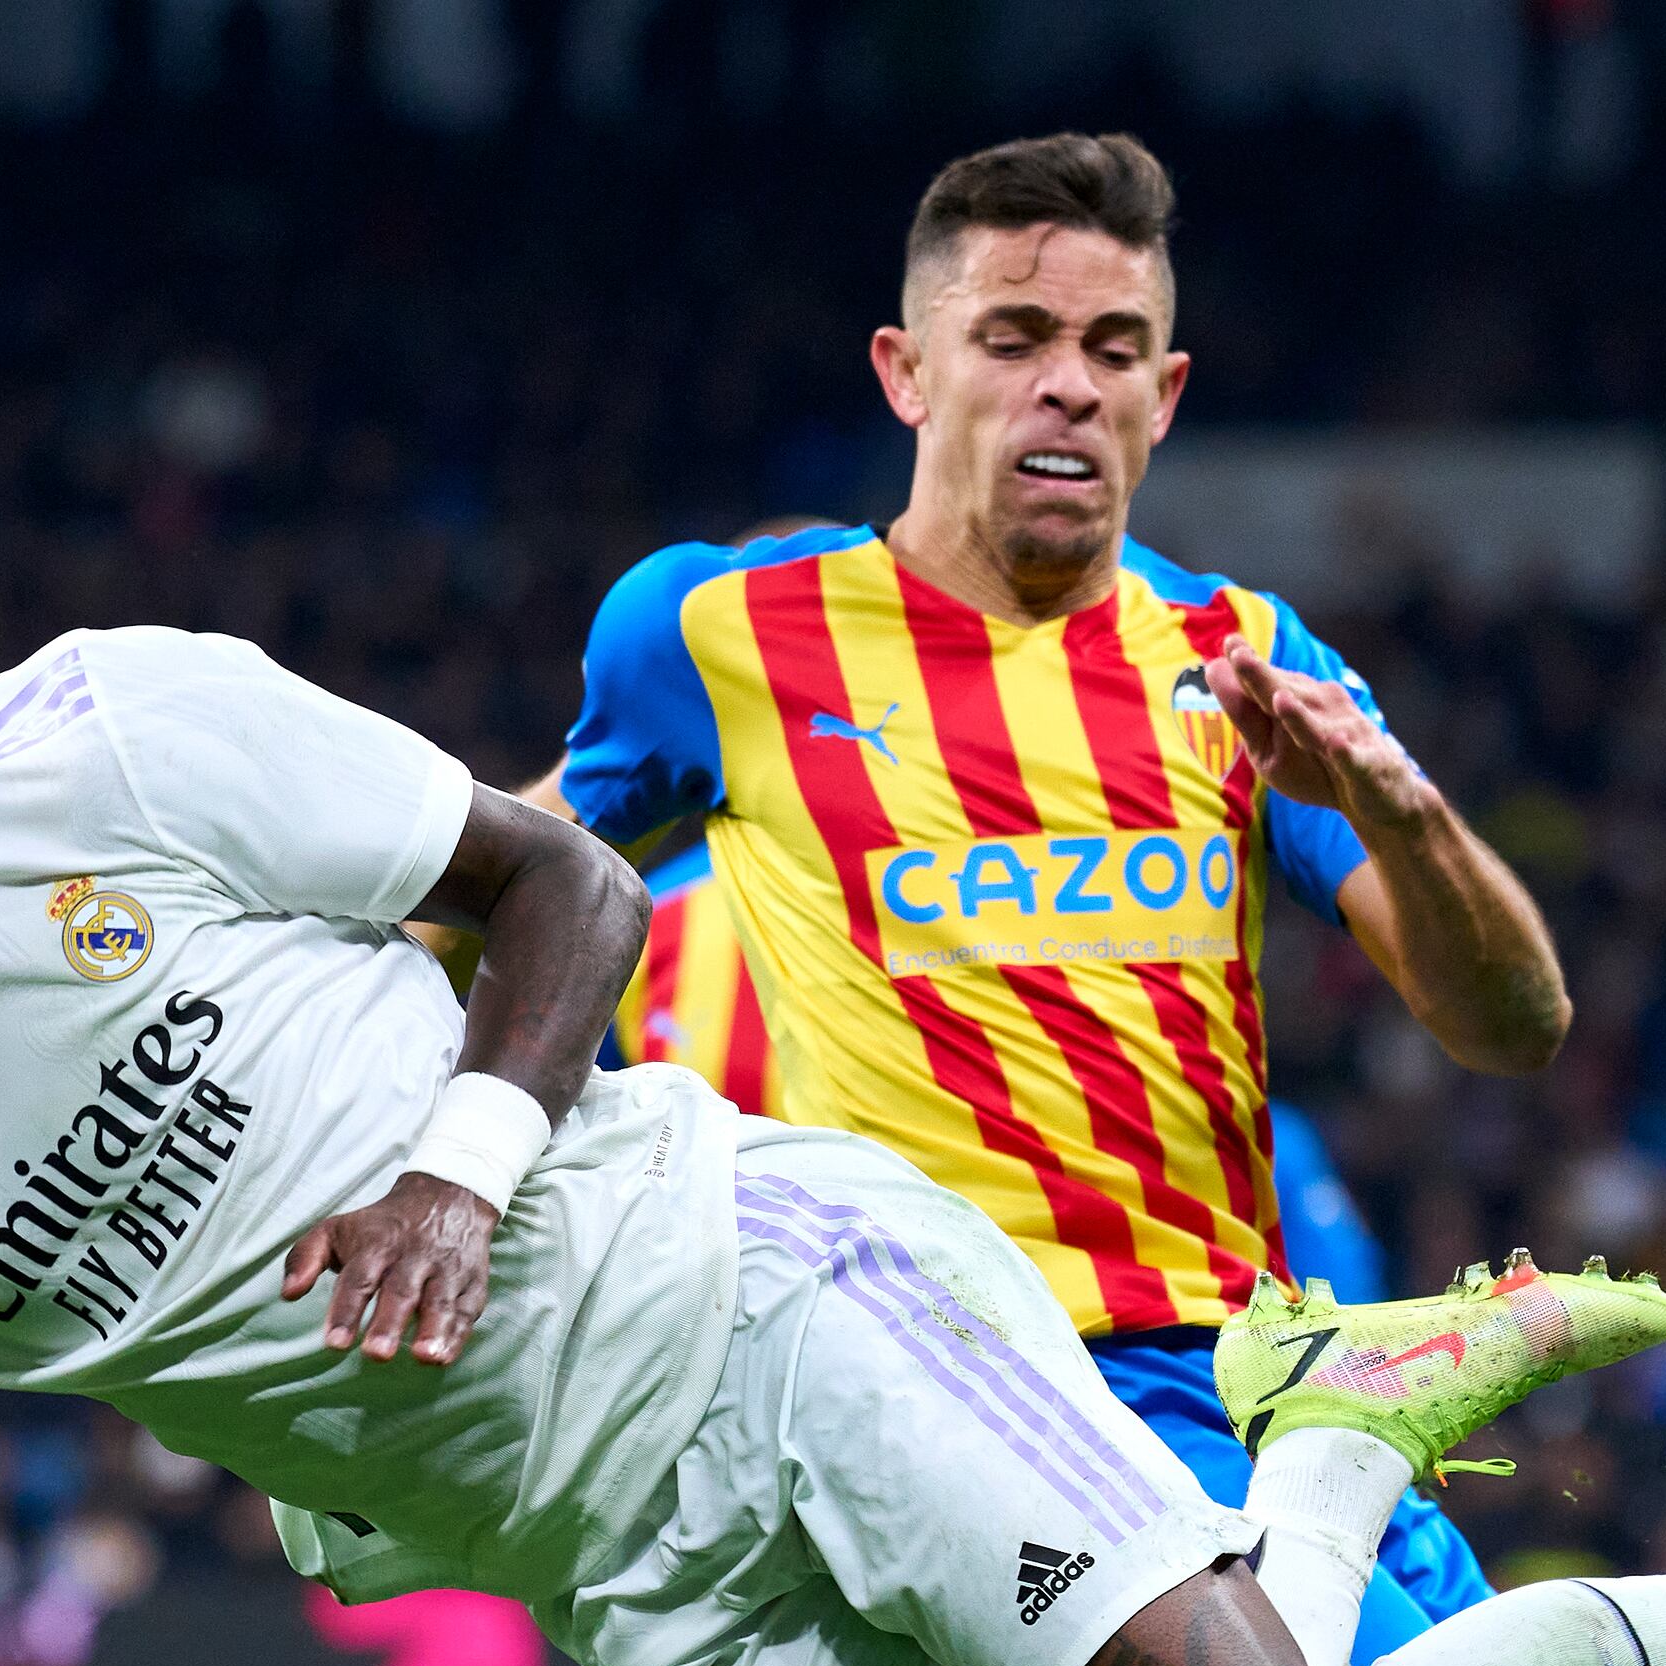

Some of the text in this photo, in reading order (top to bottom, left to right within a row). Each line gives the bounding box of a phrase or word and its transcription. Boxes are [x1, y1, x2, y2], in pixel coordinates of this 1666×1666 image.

[882, 834, 1233, 924] CAZOO
[52, 1245, 139, 1341] FLY
[106, 1078, 253, 1271] BETTER
[1020, 1552, 1096, 1626] adidas
